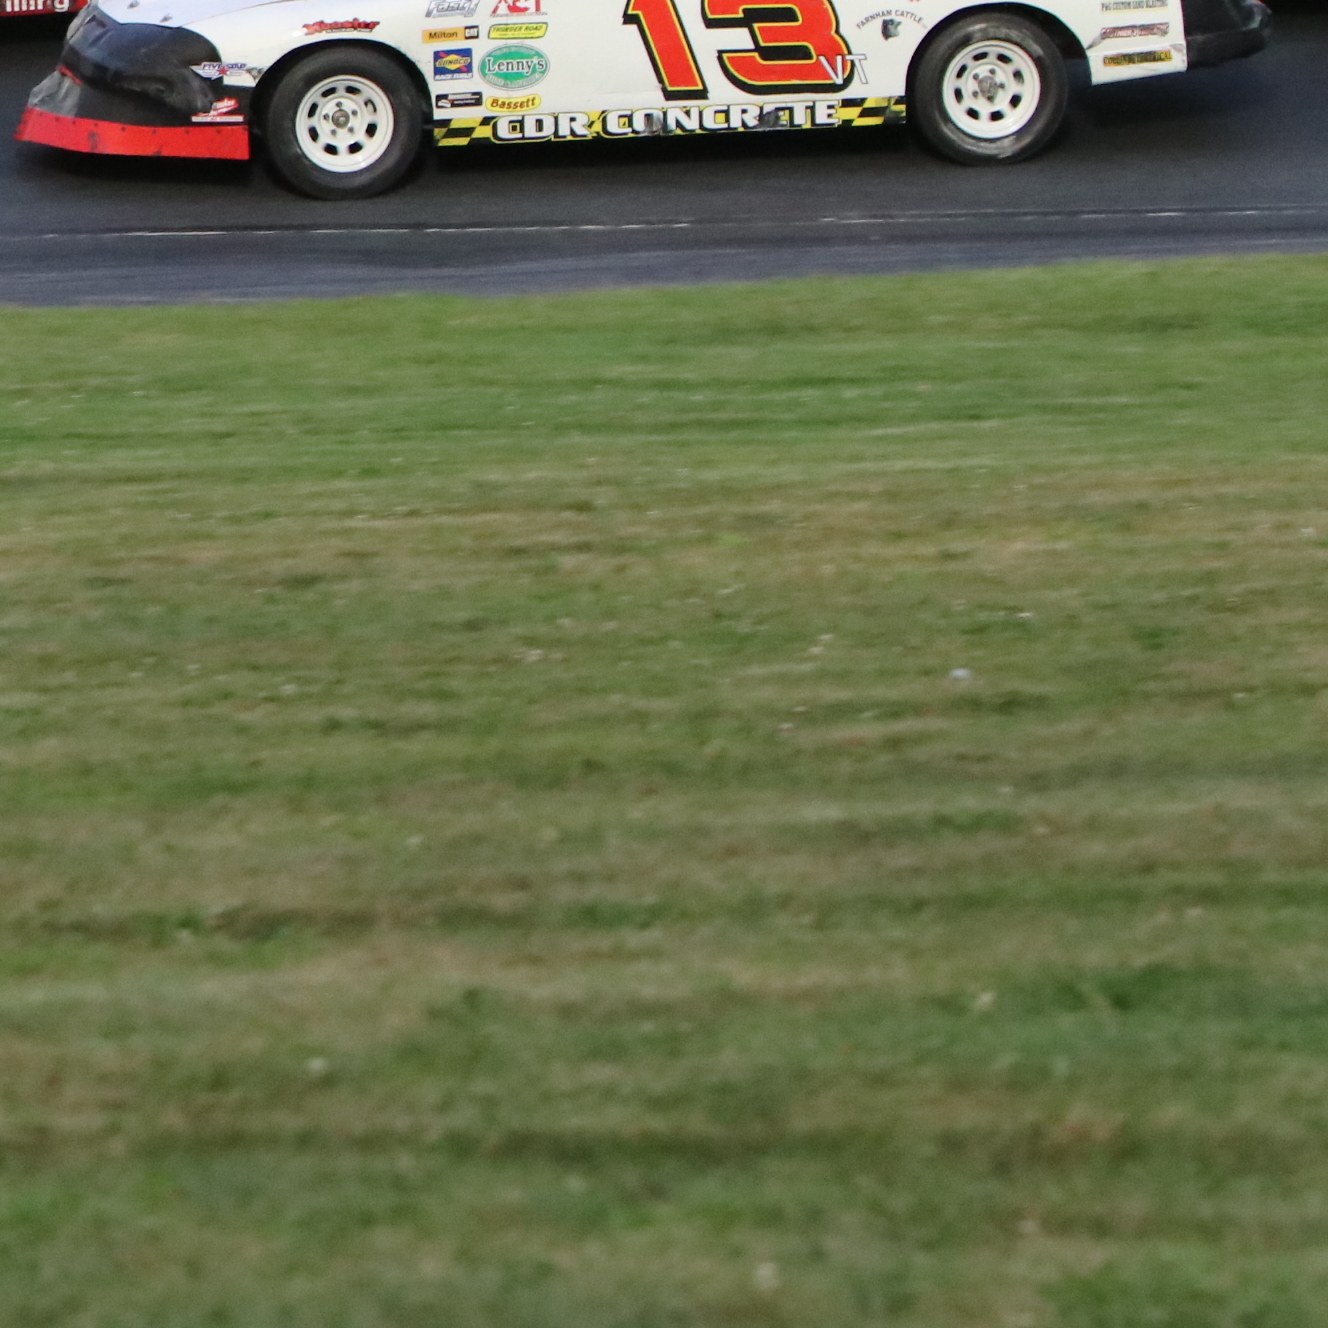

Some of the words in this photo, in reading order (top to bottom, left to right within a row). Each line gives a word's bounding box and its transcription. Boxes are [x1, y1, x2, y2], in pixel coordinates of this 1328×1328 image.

[856, 9, 893, 30] FARNHAM
[894, 9, 924, 24] CATTLE
[428, 31, 458, 40] Milton
[486, 58, 545, 75] Lenny's
[817, 53, 869, 85] VT
[490, 97, 537, 110] Bassett
[495, 112, 591, 140] CDR
